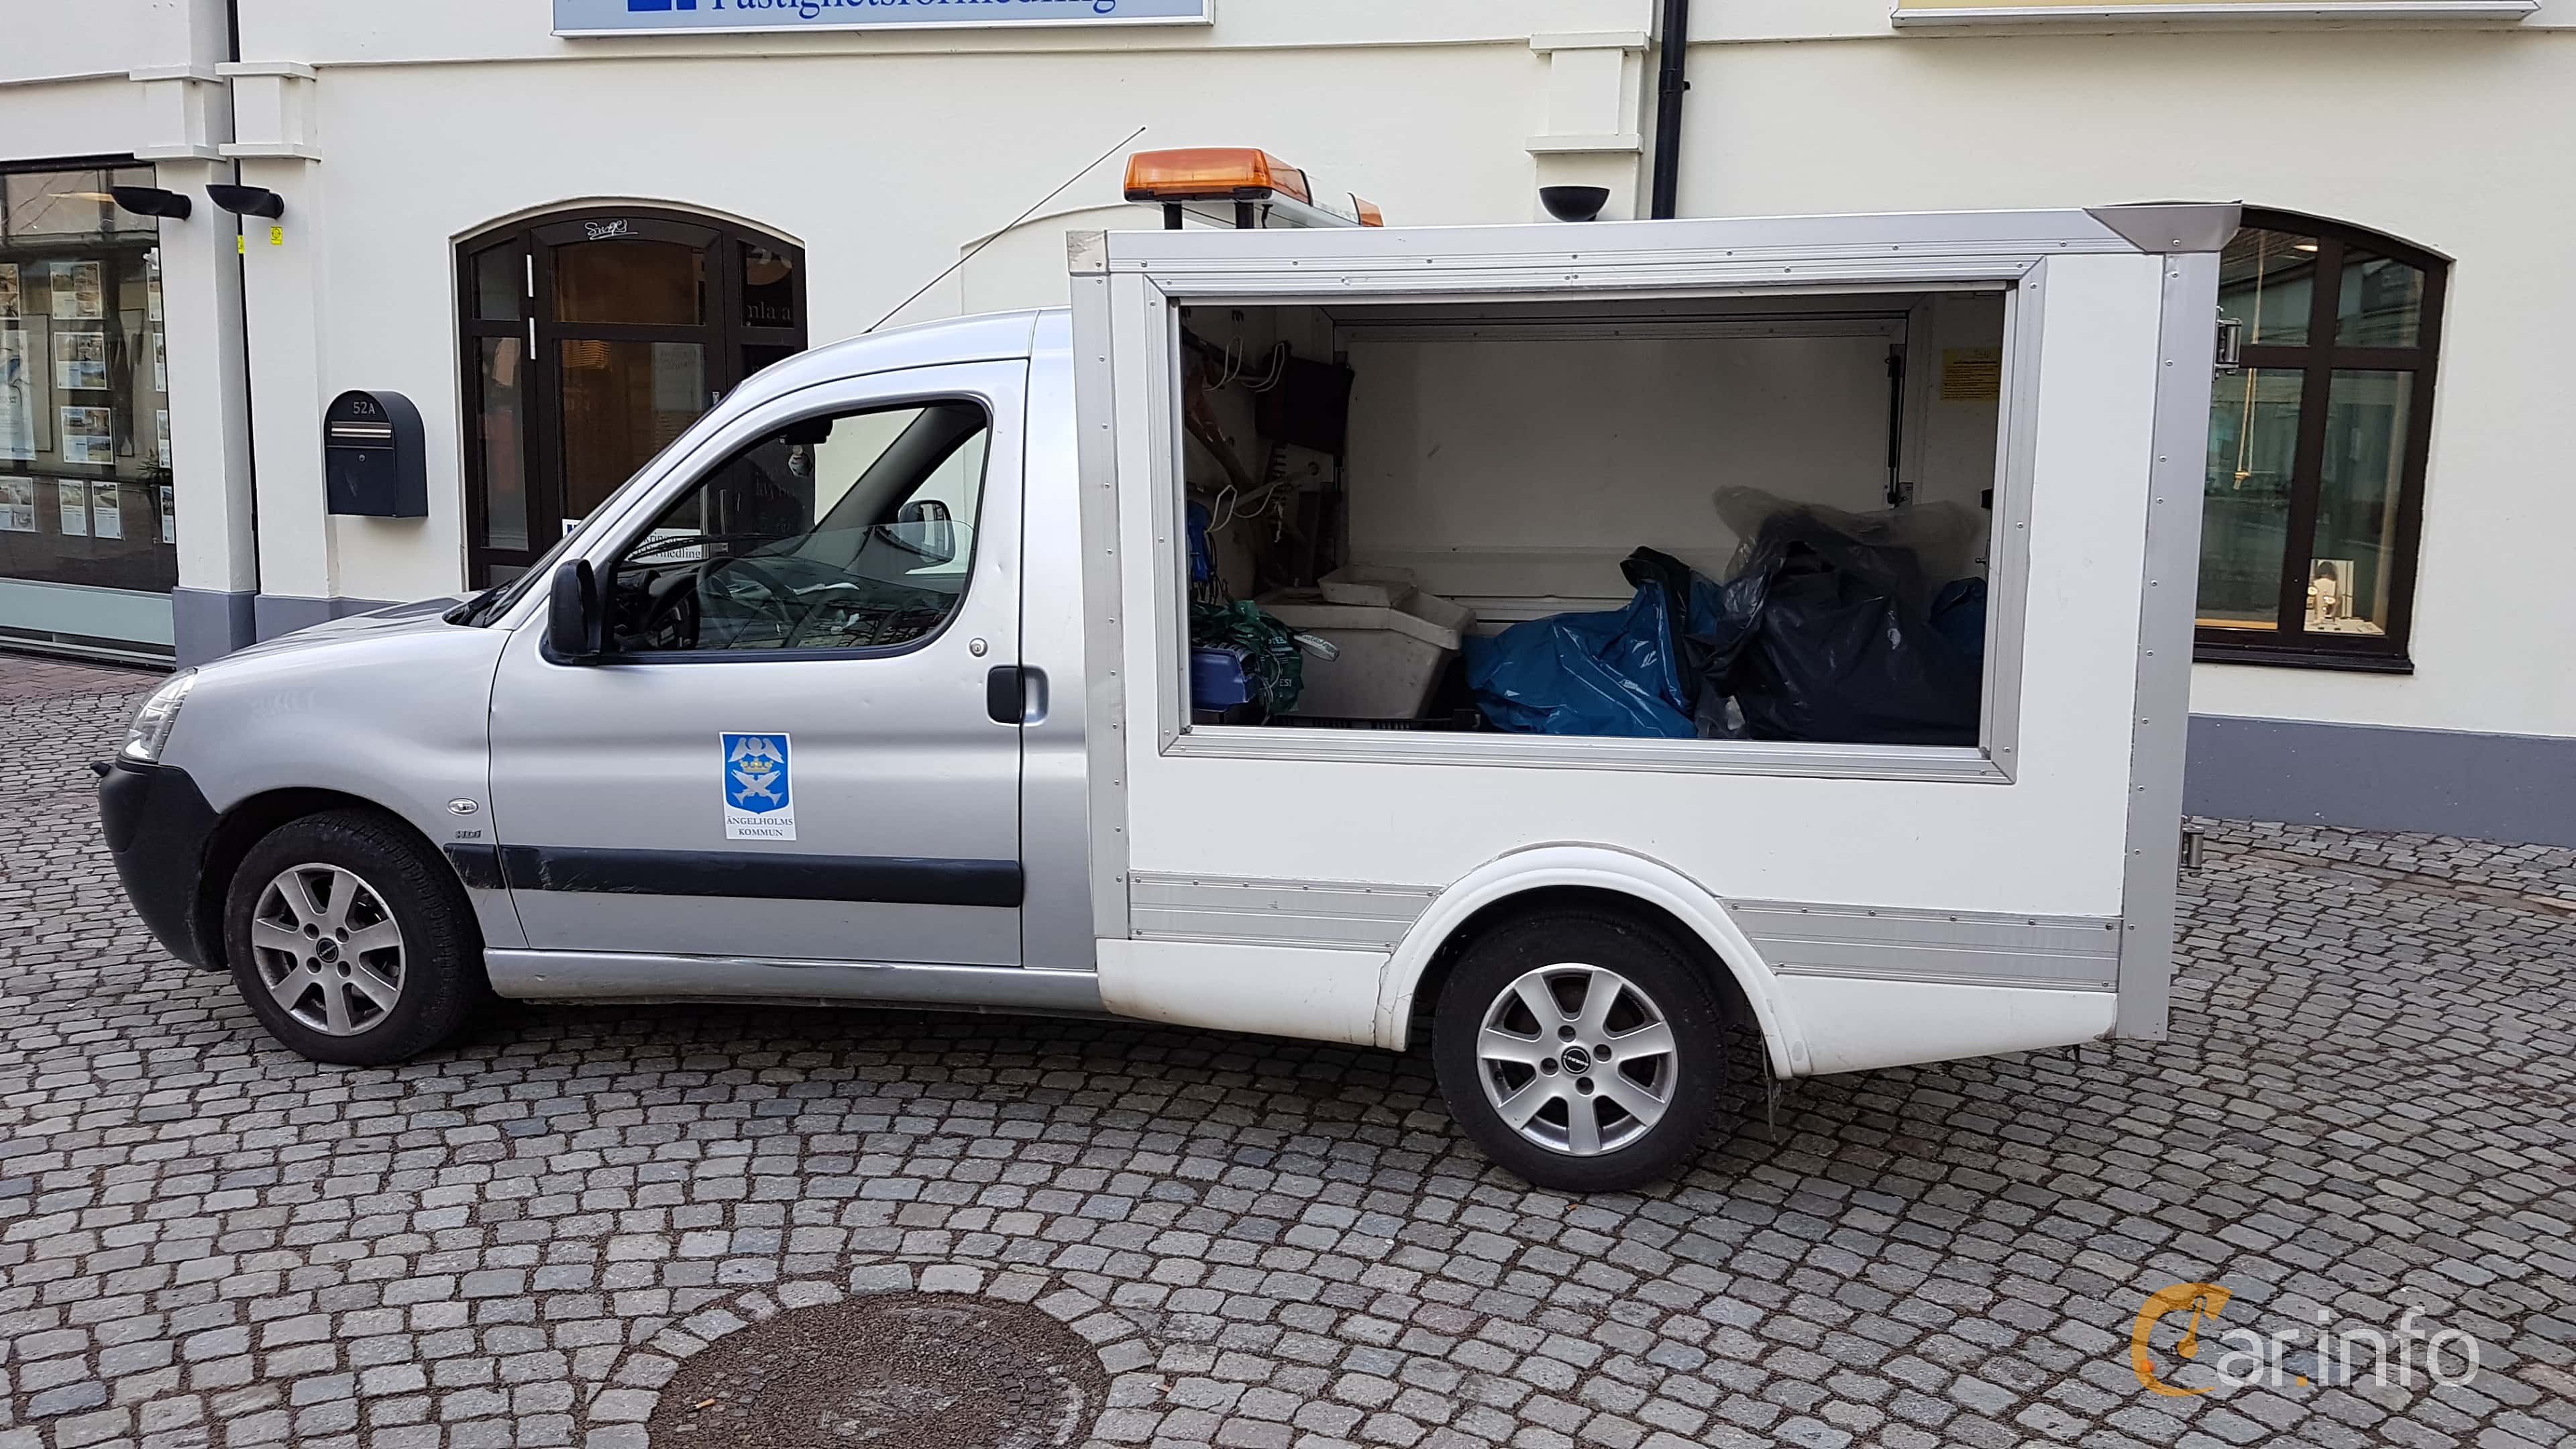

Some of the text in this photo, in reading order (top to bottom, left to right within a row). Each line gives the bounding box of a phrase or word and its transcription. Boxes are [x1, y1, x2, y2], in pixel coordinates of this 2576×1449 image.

[354, 402, 376, 415] 52A
[727, 816, 793, 826] ÄNGELHOLMS
[739, 828, 783, 837] KOMMUN
